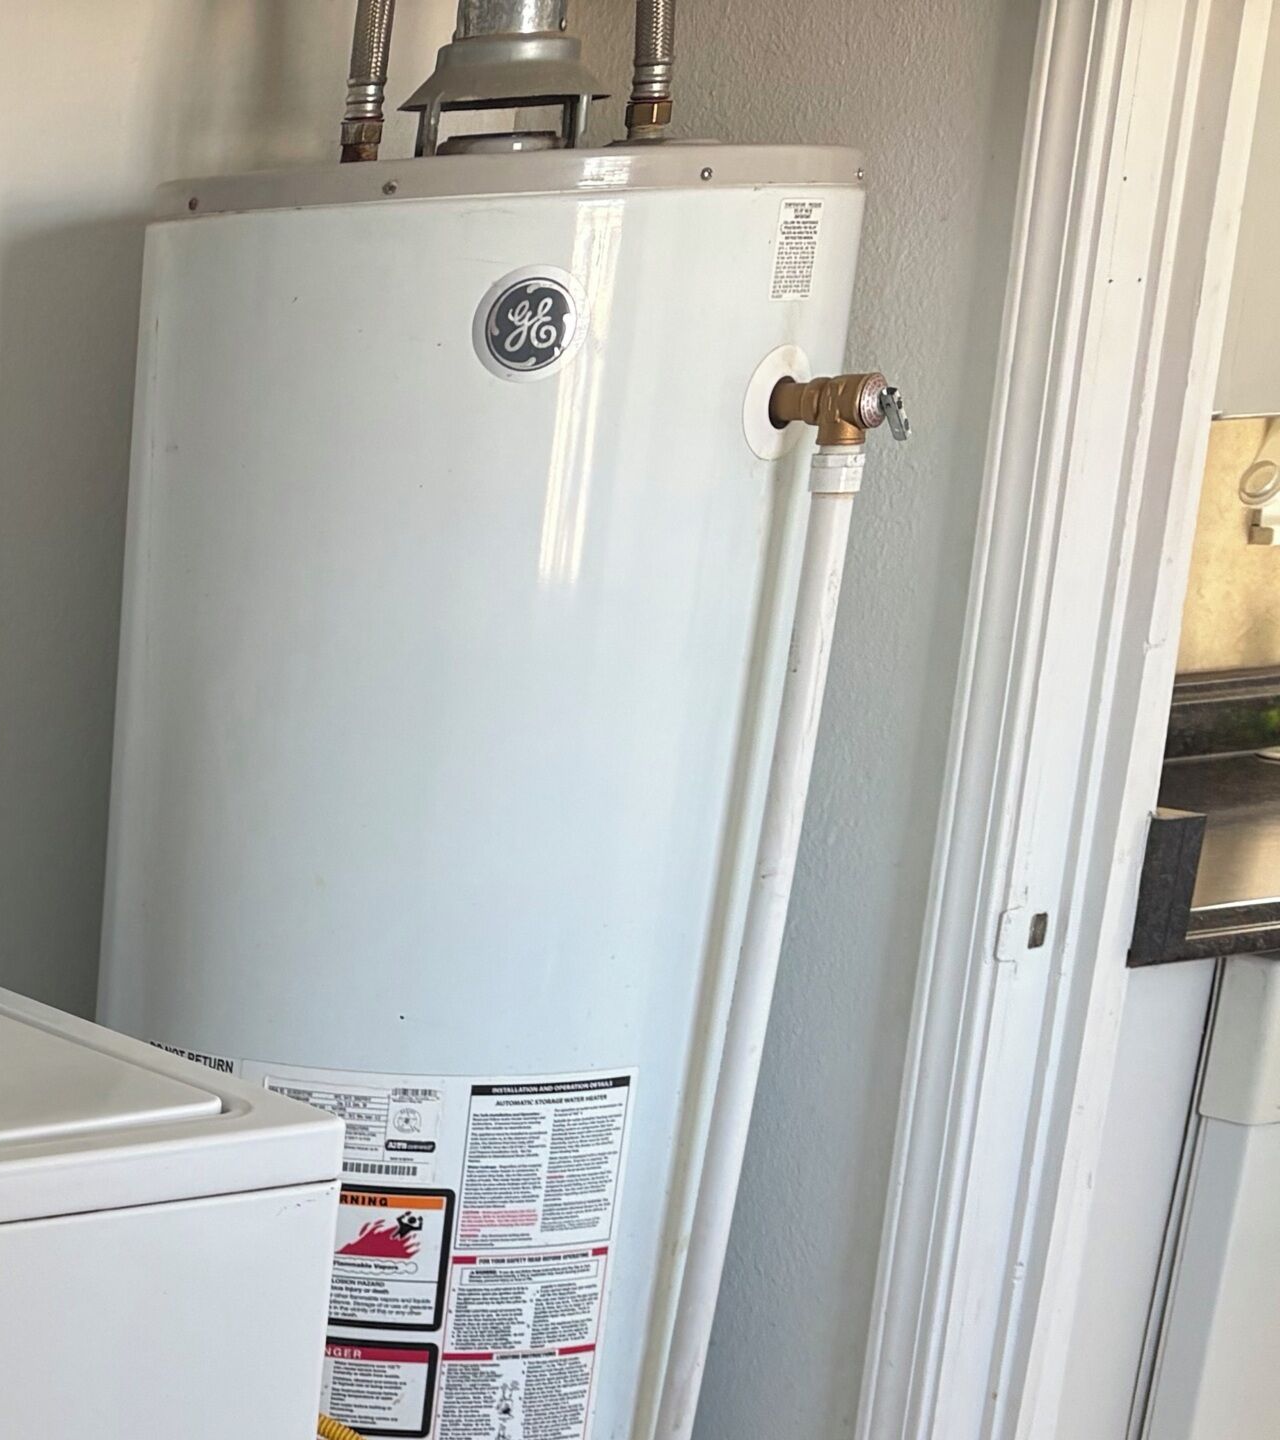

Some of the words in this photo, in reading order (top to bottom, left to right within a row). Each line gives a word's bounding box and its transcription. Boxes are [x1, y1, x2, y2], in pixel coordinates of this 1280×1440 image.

[187, 1051, 234, 1074] RETURN
[340, 1194, 389, 1207] RNING
[325, 1347, 362, 1359] NGER
